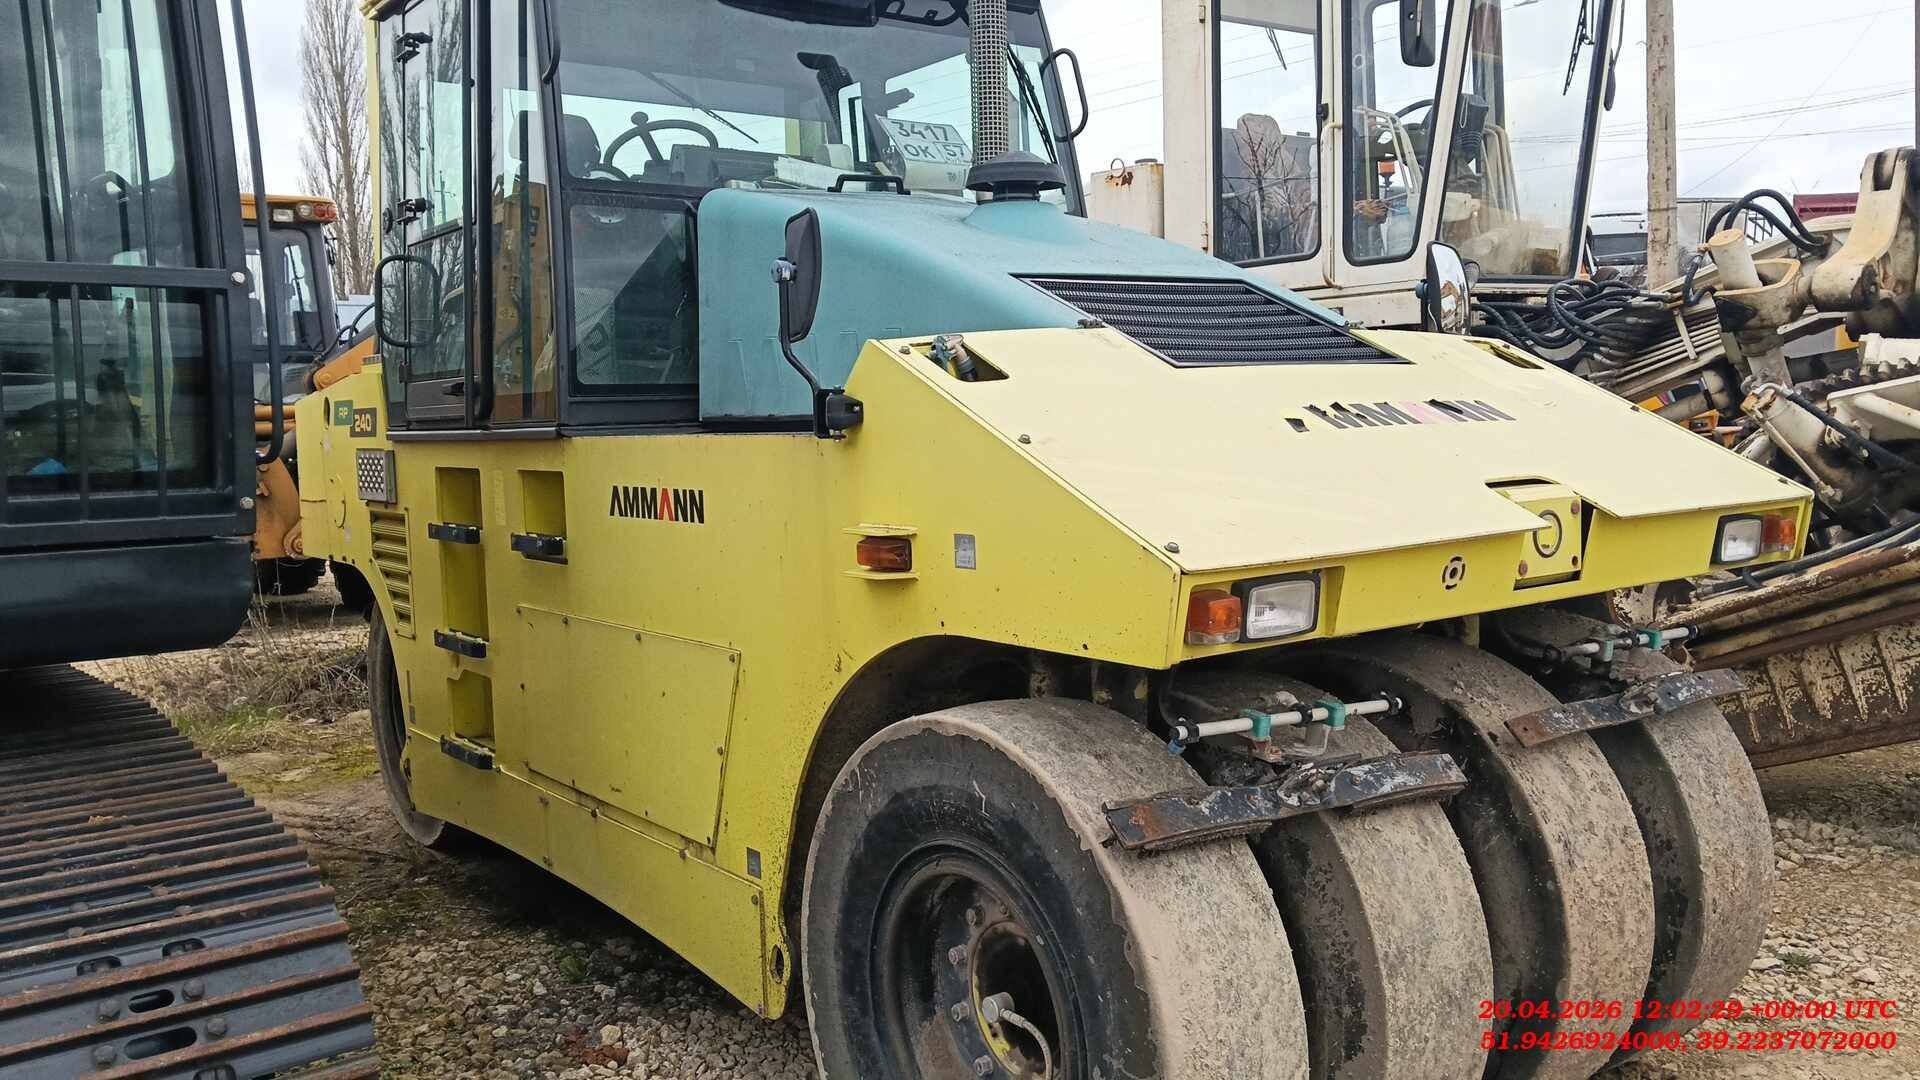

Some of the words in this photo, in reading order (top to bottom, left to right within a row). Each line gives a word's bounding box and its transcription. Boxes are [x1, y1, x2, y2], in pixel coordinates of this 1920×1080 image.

[891, 121, 949, 142] 3417
[943, 144, 965, 157] 57
[354, 413, 372, 432] 240
[609, 485, 705, 524] AMMANN
